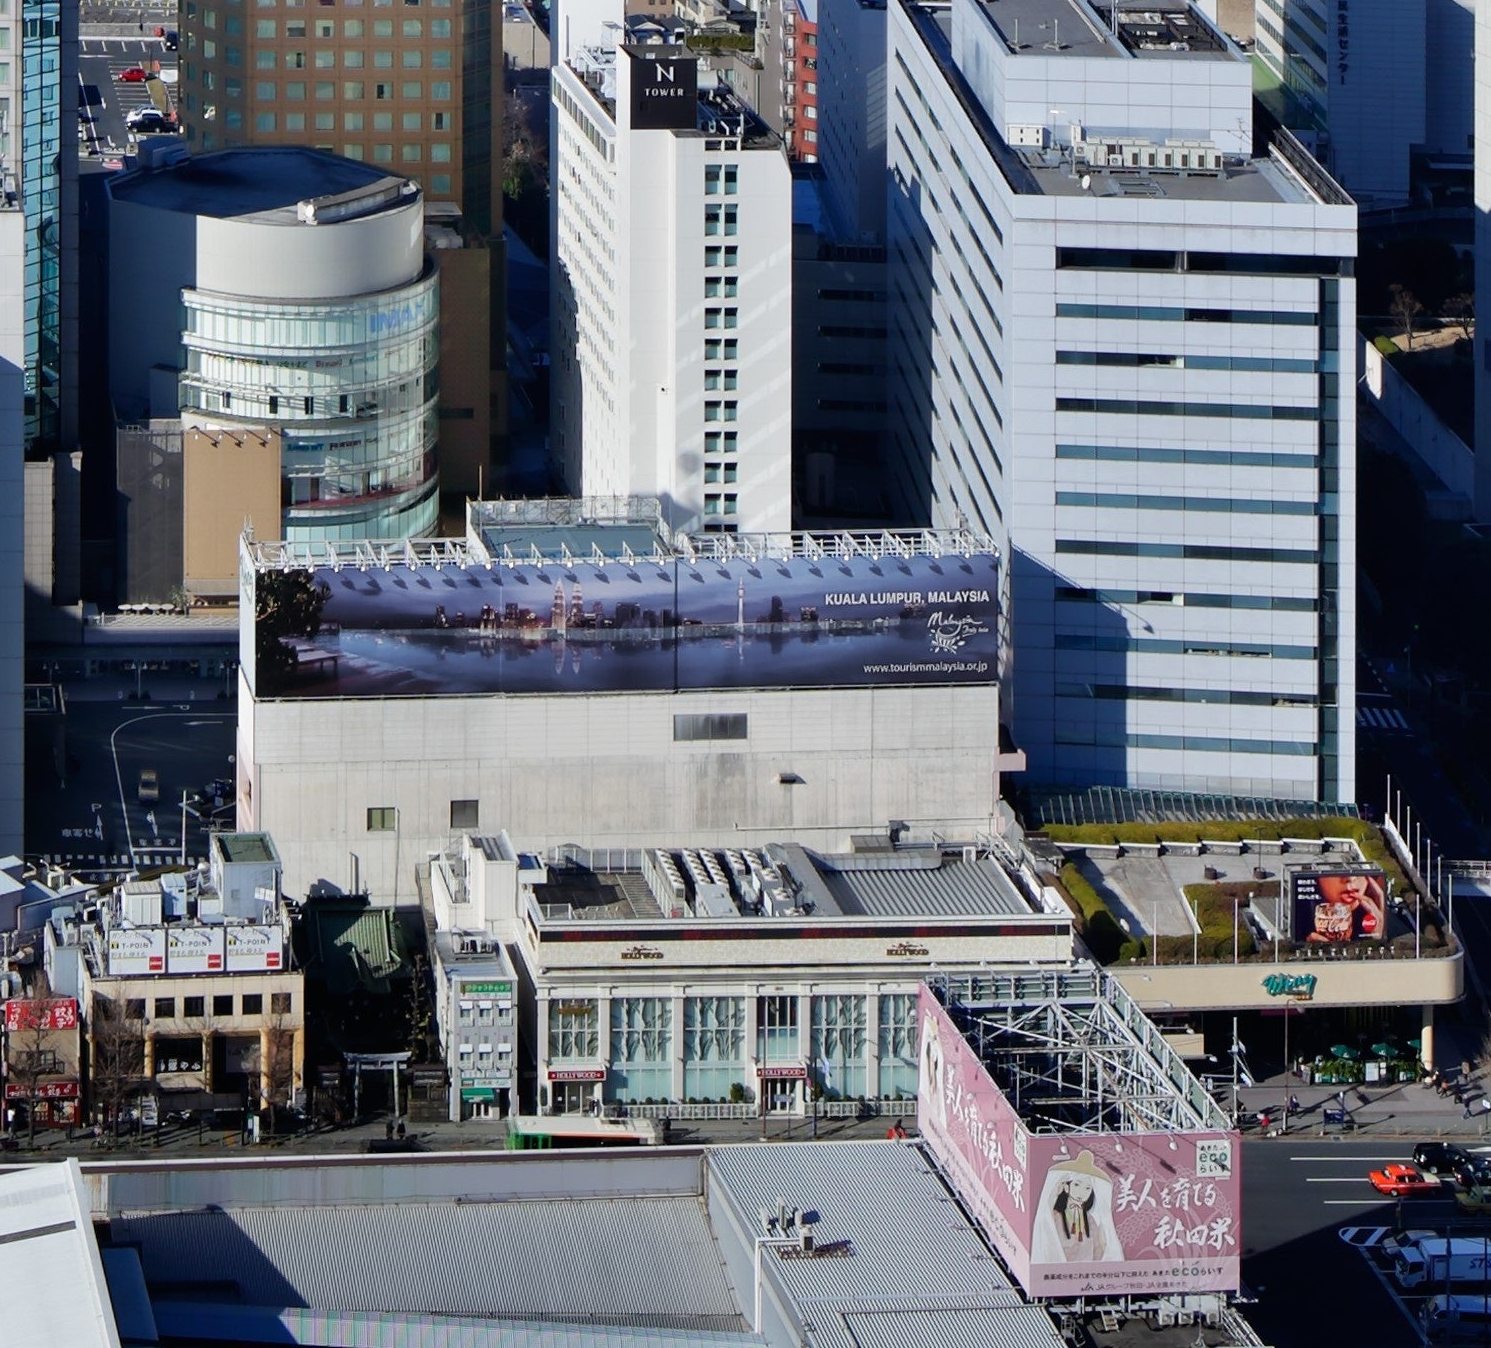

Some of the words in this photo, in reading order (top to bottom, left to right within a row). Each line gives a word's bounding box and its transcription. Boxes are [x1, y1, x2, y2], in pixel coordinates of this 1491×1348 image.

[656, 63, 675, 82] N
[644, 87, 684, 97] TOWER
[825, 593, 868, 605] KUALA
[870, 592, 925, 604] LUMPUR,
[928, 590, 990, 603] MALAYSIA
[863, 661, 988, 673] www.tourismmalaysia.or.jp
[1199, 1153, 1228, 1163] eco
[1116, 1174, 1217, 1212] 美人を育てる
[1154, 1216, 1236, 1250] 秋田米
